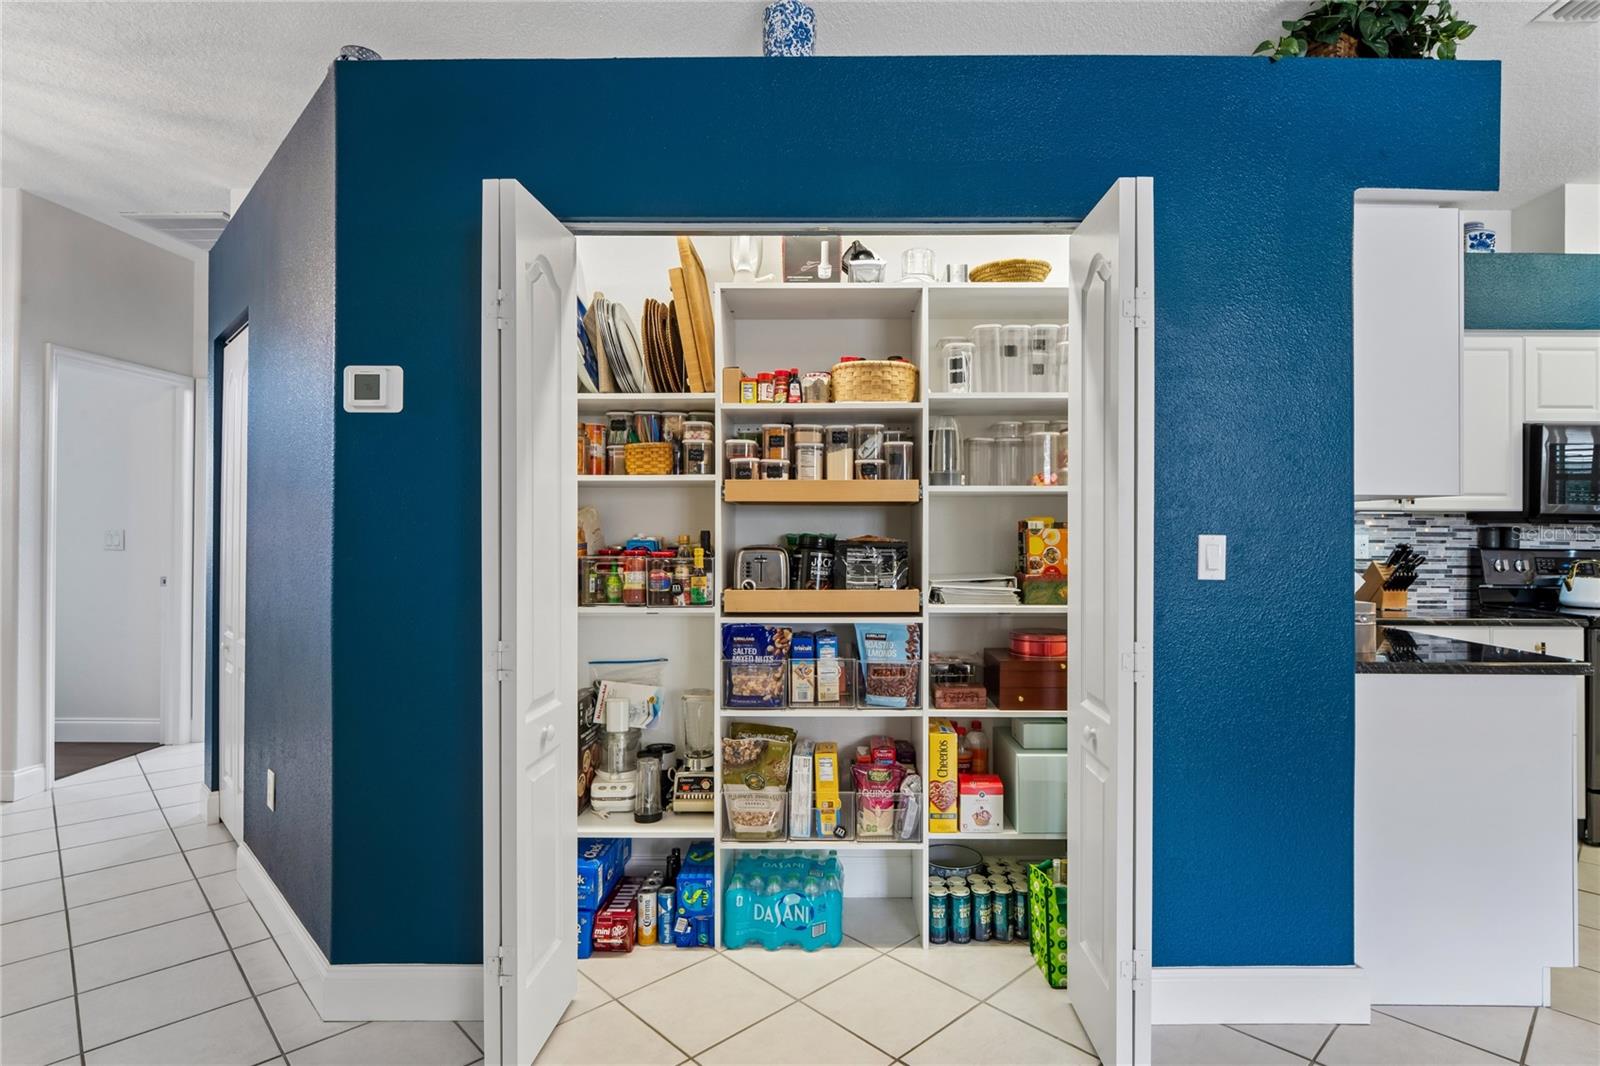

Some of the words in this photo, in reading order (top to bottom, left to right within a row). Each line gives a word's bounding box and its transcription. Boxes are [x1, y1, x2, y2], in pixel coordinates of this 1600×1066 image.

[732, 647, 757, 655] SALTED
[732, 655, 754, 663] MIXED
[755, 655, 775, 663] NUTS
[937, 740, 948, 778] Cheerios
[642, 899, 652, 927] Corona
[753, 899, 809, 929] DASANI
[594, 927, 611, 935] mini
